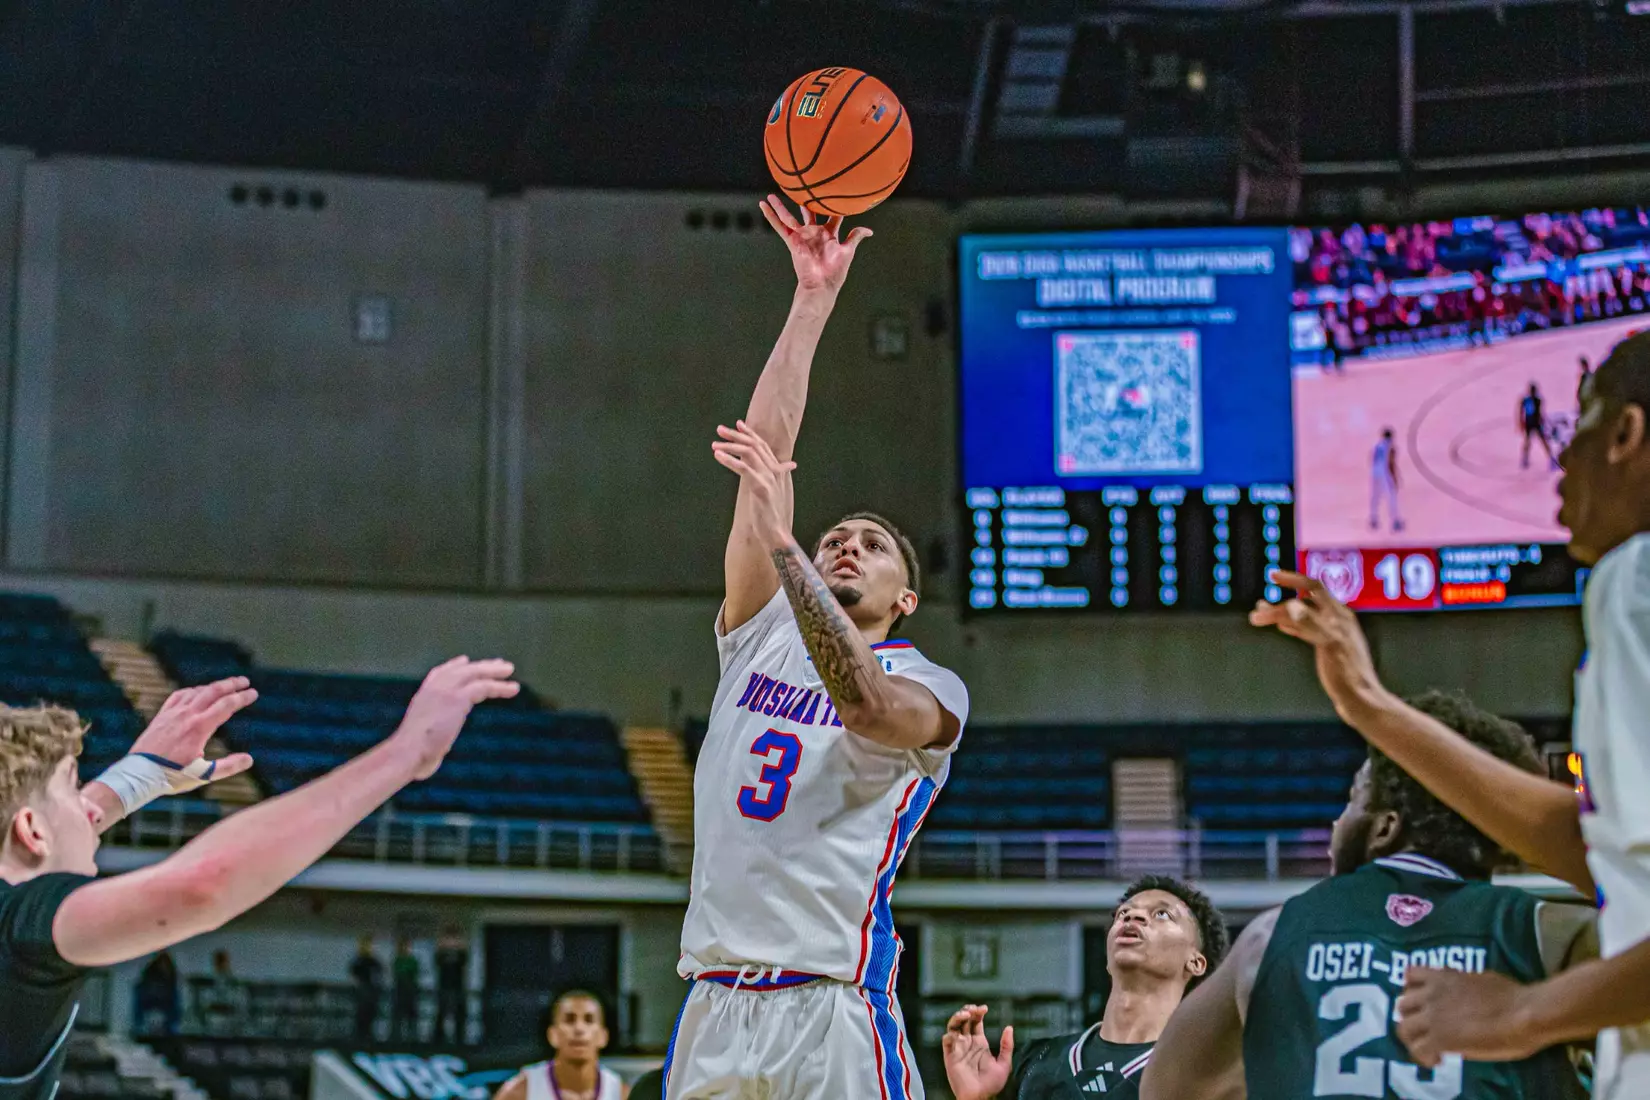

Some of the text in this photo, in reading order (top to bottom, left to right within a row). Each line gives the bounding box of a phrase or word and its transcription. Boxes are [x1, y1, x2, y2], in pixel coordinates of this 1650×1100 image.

[796, 67, 847, 118] ELITE
[1374, 553, 1435, 600] 19
[736, 728, 803, 822] 3
